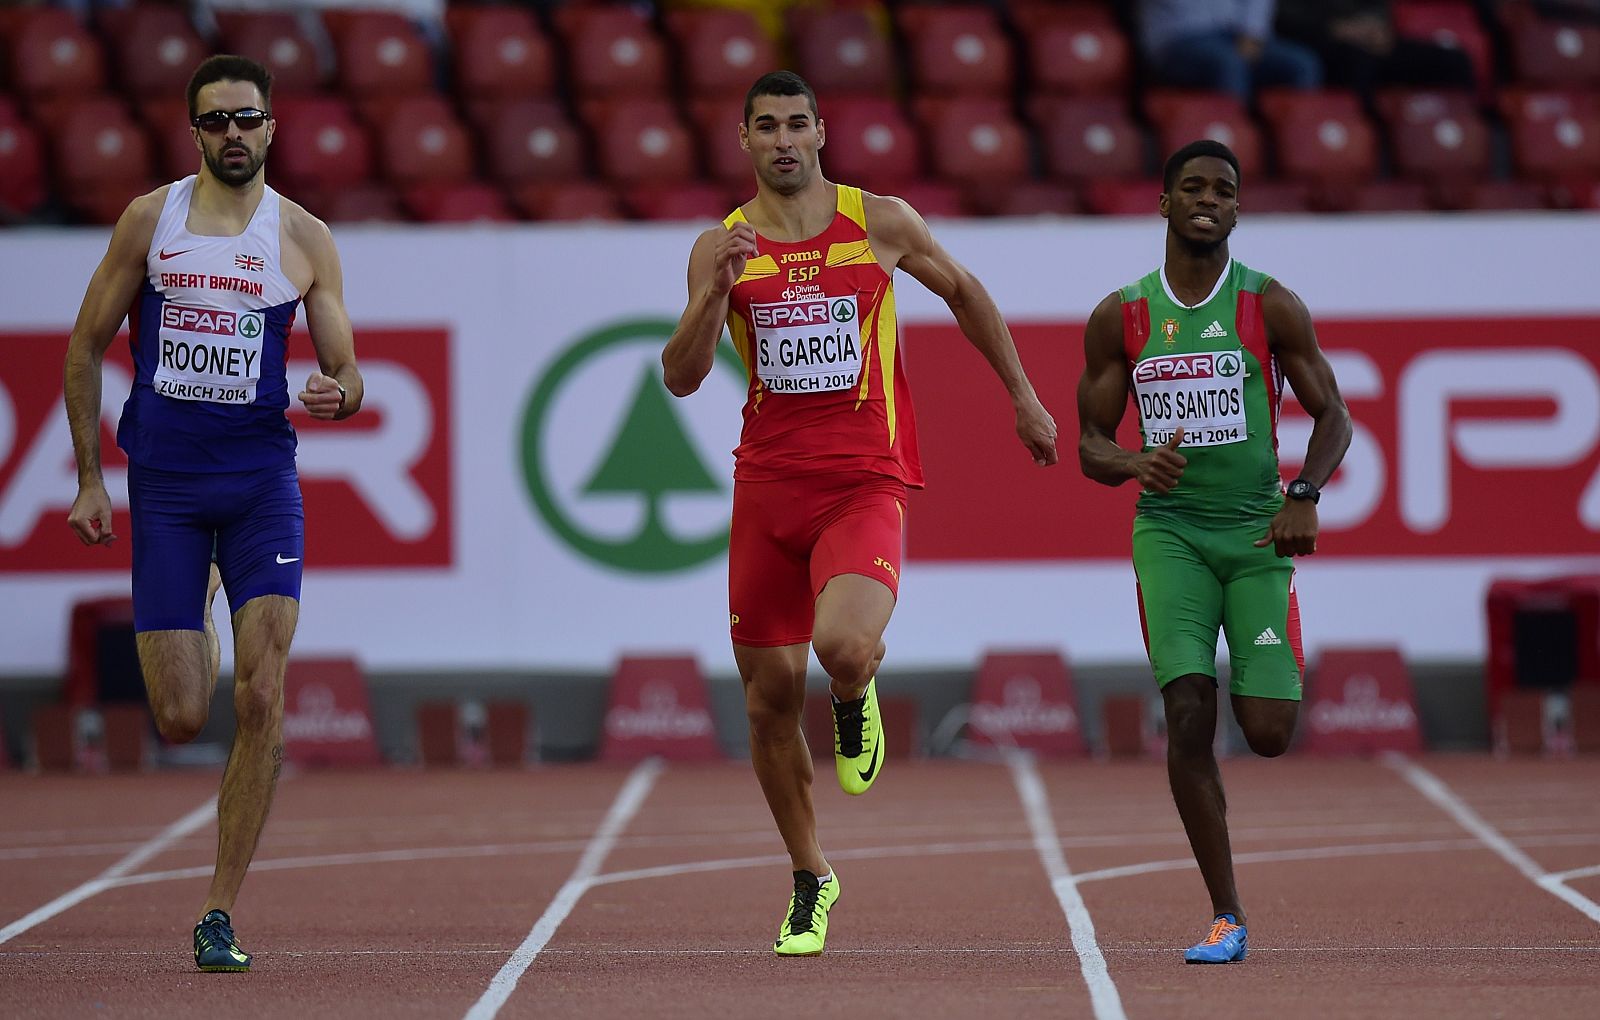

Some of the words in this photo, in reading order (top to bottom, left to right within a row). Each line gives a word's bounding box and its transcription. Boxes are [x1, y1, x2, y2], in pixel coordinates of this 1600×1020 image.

[161, 273, 206, 288] GREAT
[209, 276, 263, 296] BRITAIN
[788, 265, 820, 283] ESP
[795, 284, 820, 293] Divina
[165, 308, 234, 333] SPAR
[755, 304, 828, 326] SPAR
[1200, 330, 1227, 338] adidas
[162, 339, 257, 378] ROONEY
[759, 338, 775, 367] S.
[779, 327, 858, 368] GARCÍA
[1137, 357, 1213, 381] SPAR
[159, 379, 214, 399] ZÜRICH
[217, 388, 248, 401] 2014
[765, 375, 820, 391] ZÜRICH
[824, 374, 854, 389] 2014
[1140, 391, 1172, 420] DOS
[1176, 387, 1240, 419] SANTOS
[1206, 427, 1239, 442] 2014
